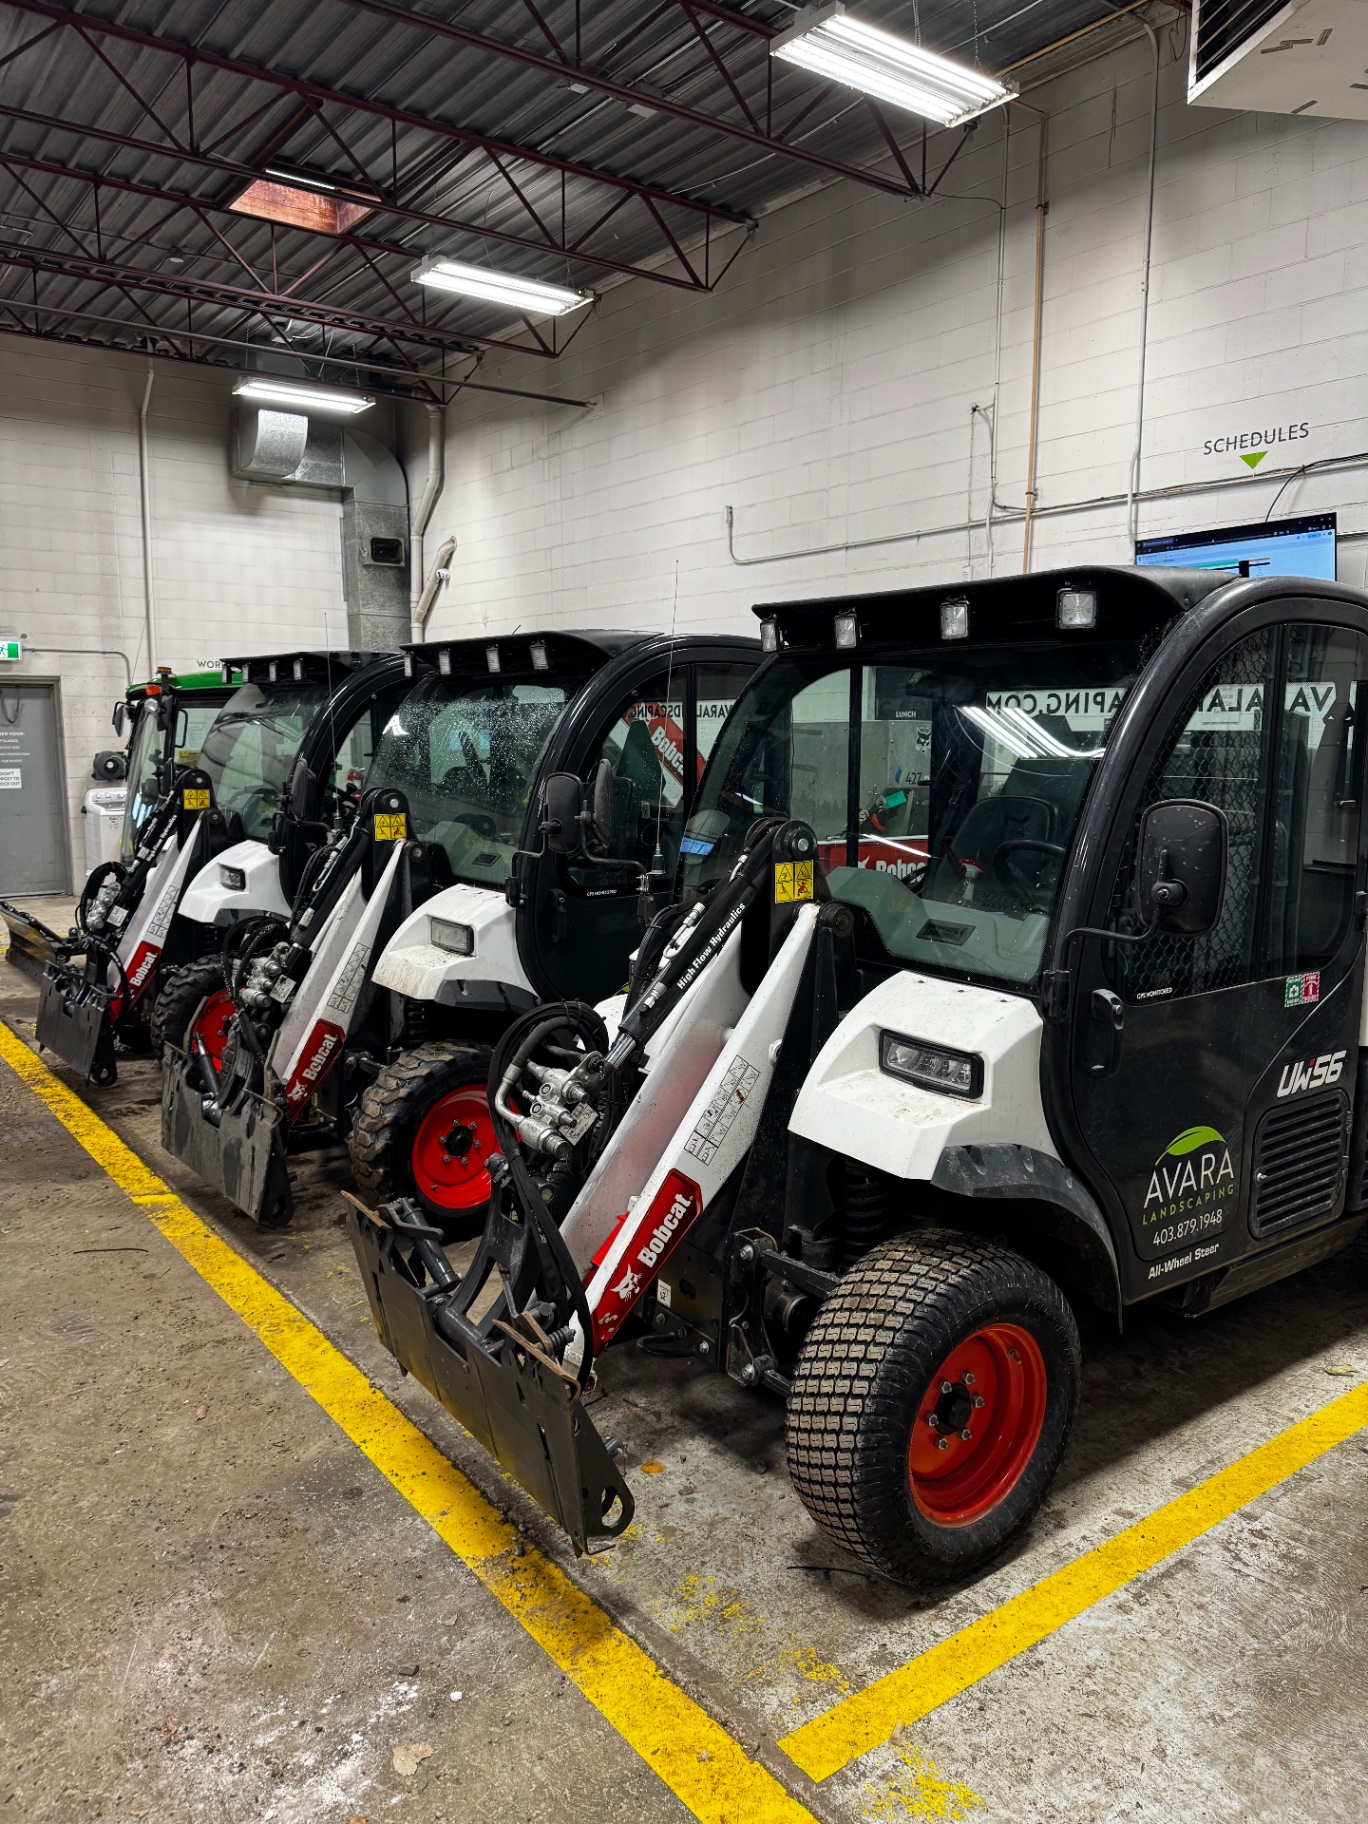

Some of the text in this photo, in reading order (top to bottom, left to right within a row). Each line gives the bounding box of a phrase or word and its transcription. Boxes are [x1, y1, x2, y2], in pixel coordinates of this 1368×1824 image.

[1203, 422, 1310, 456] SCHEDULES
[895, 710, 917, 718] LUNCH
[676, 902, 746, 990] High Flow Hydraulics
[129, 951, 158, 987] Bobcat
[302, 1033, 338, 1081] Bobcat
[1143, 1147, 1235, 1209] AVARA
[1142, 1184, 1234, 1226] LANDSCAPING
[637, 1193, 692, 1268] Bobcat
[1152, 1208, 1223, 1246] 403.879.1948
[1148, 1243, 1220, 1280] All-Wheel Steer
